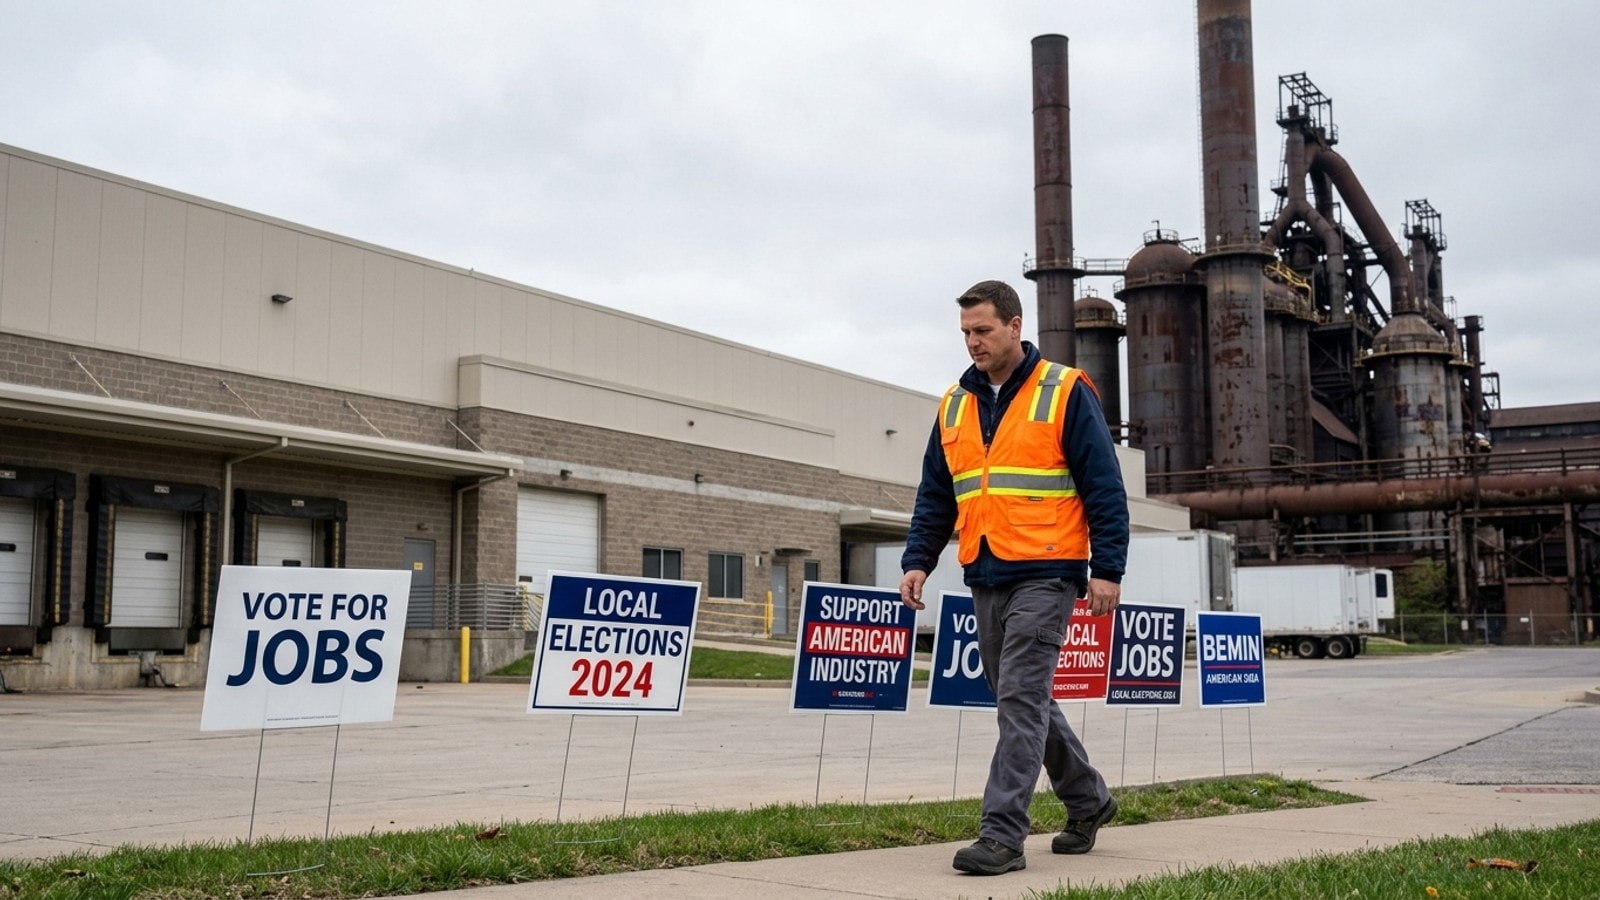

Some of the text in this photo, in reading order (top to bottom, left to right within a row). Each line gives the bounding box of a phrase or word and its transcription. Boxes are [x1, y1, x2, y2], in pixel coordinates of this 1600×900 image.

[242, 592, 388, 620] VOTE FOR
[583, 587, 662, 619] LOCAL
[820, 595, 904, 624] SUPPORT
[952, 613, 978, 634] VO
[1063, 623, 1099, 646] CAL
[1120, 610, 1175, 641] VOTE
[549, 624, 684, 657] ELECTIONS
[809, 625, 906, 655] AMERICAN
[1202, 634, 1260, 661] BEMIN
[226, 628, 385, 687] JOBS
[809, 657, 901, 685] INDUSTRY
[942, 639, 986, 680] JO
[1057, 651, 1105, 669] ECTIONS
[1116, 643, 1174, 678] JOBS
[569, 658, 653, 698] 2024
